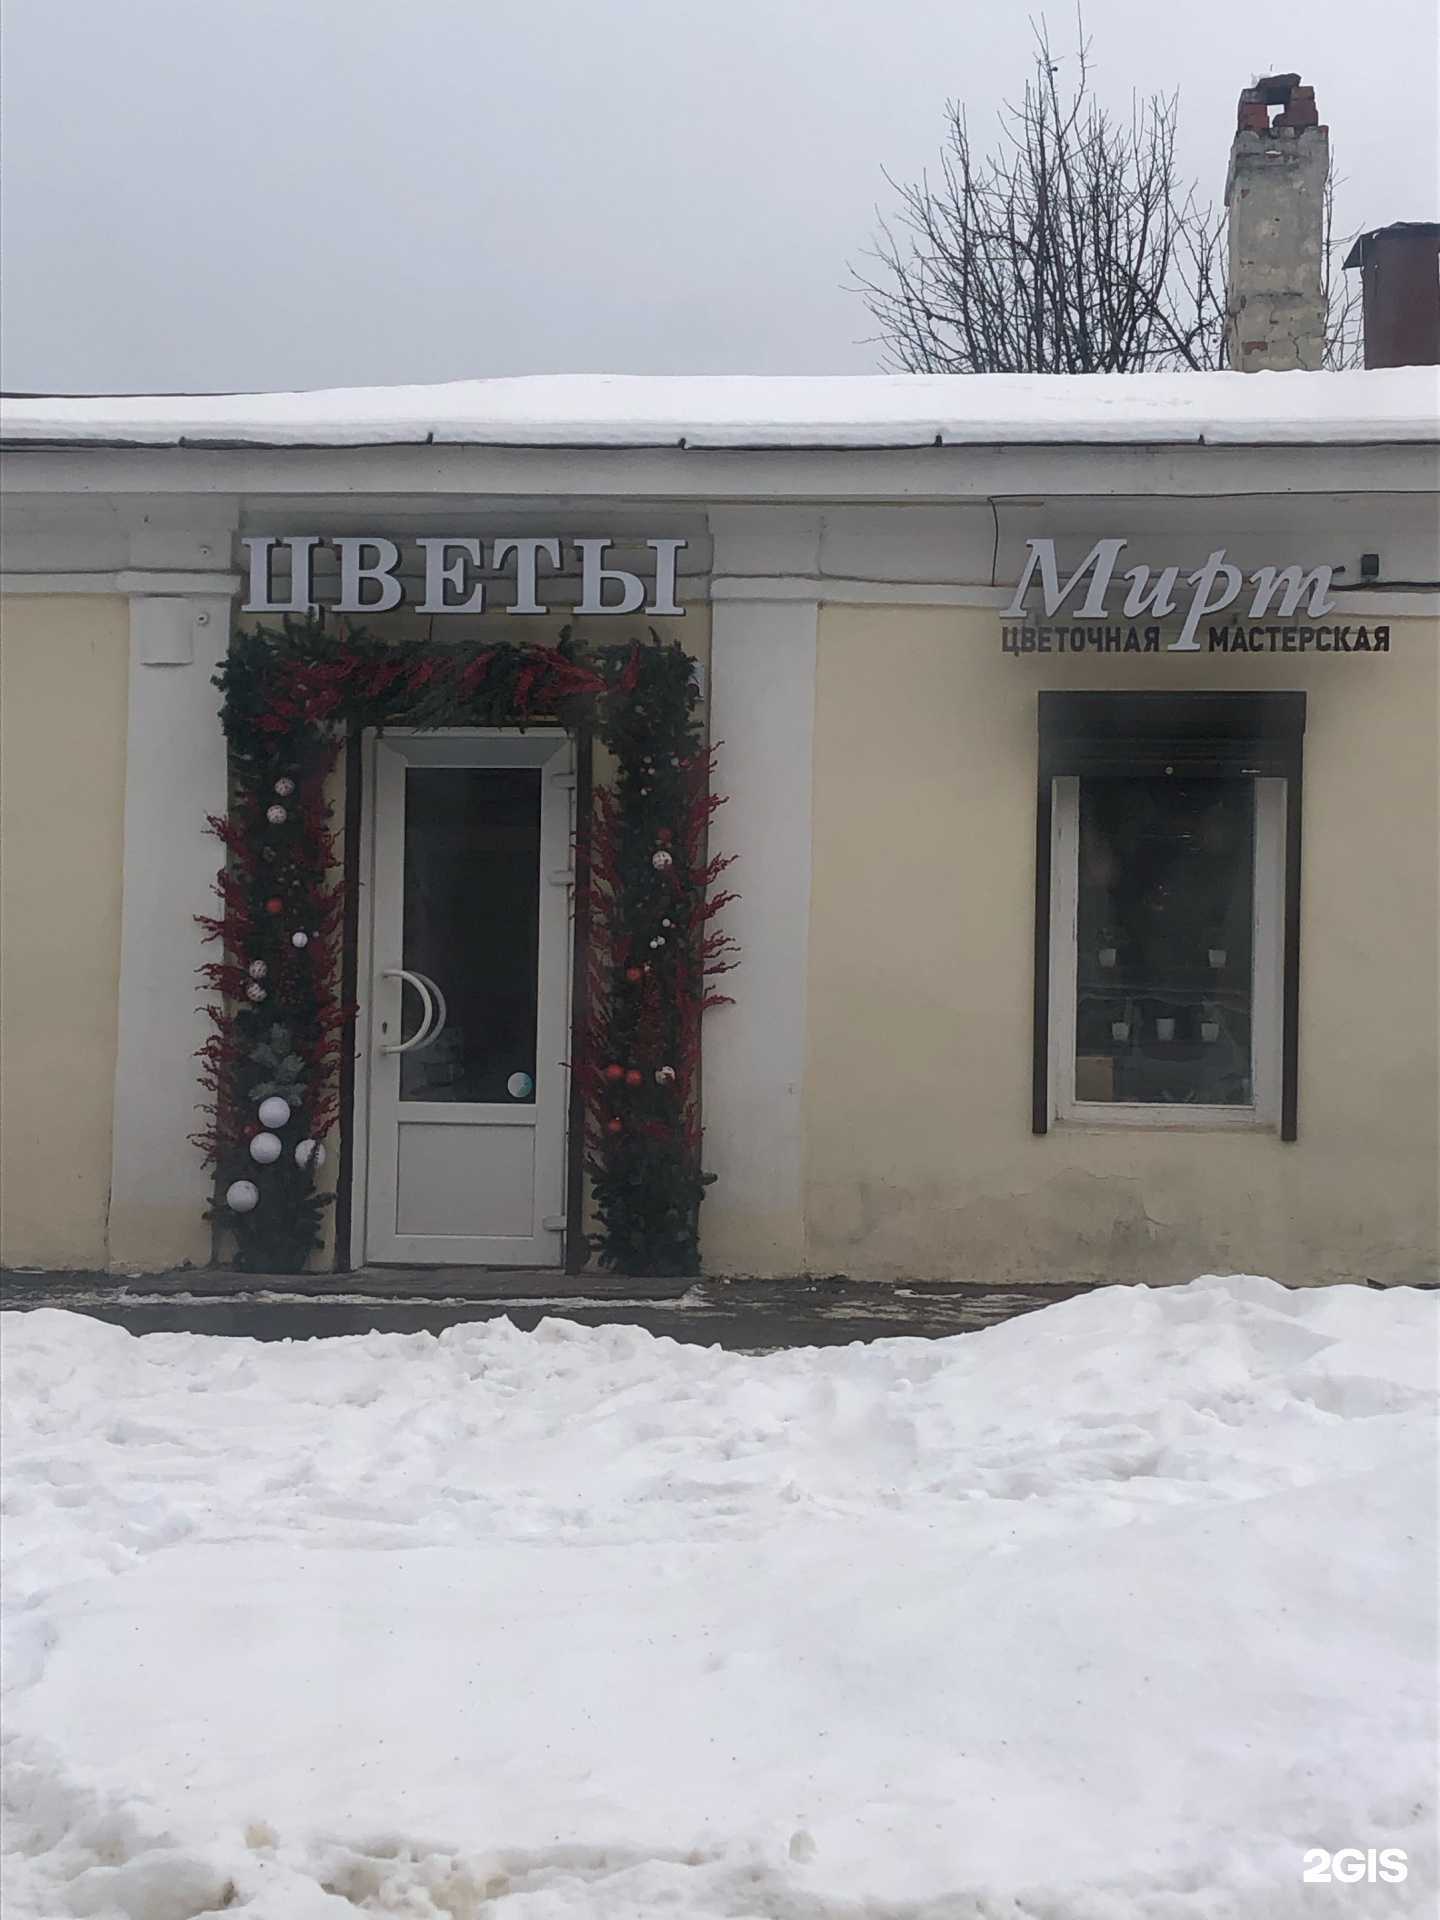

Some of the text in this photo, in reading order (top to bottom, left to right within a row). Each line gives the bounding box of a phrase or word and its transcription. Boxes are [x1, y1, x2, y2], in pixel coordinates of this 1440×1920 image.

[241, 536, 687, 618] ЦВЕТЫ
[1000, 538, 1337, 652] Мирт
[1002, 626, 1391, 656] ЦВЕТОЧНАЯ МАСТЕРСКАЯ
